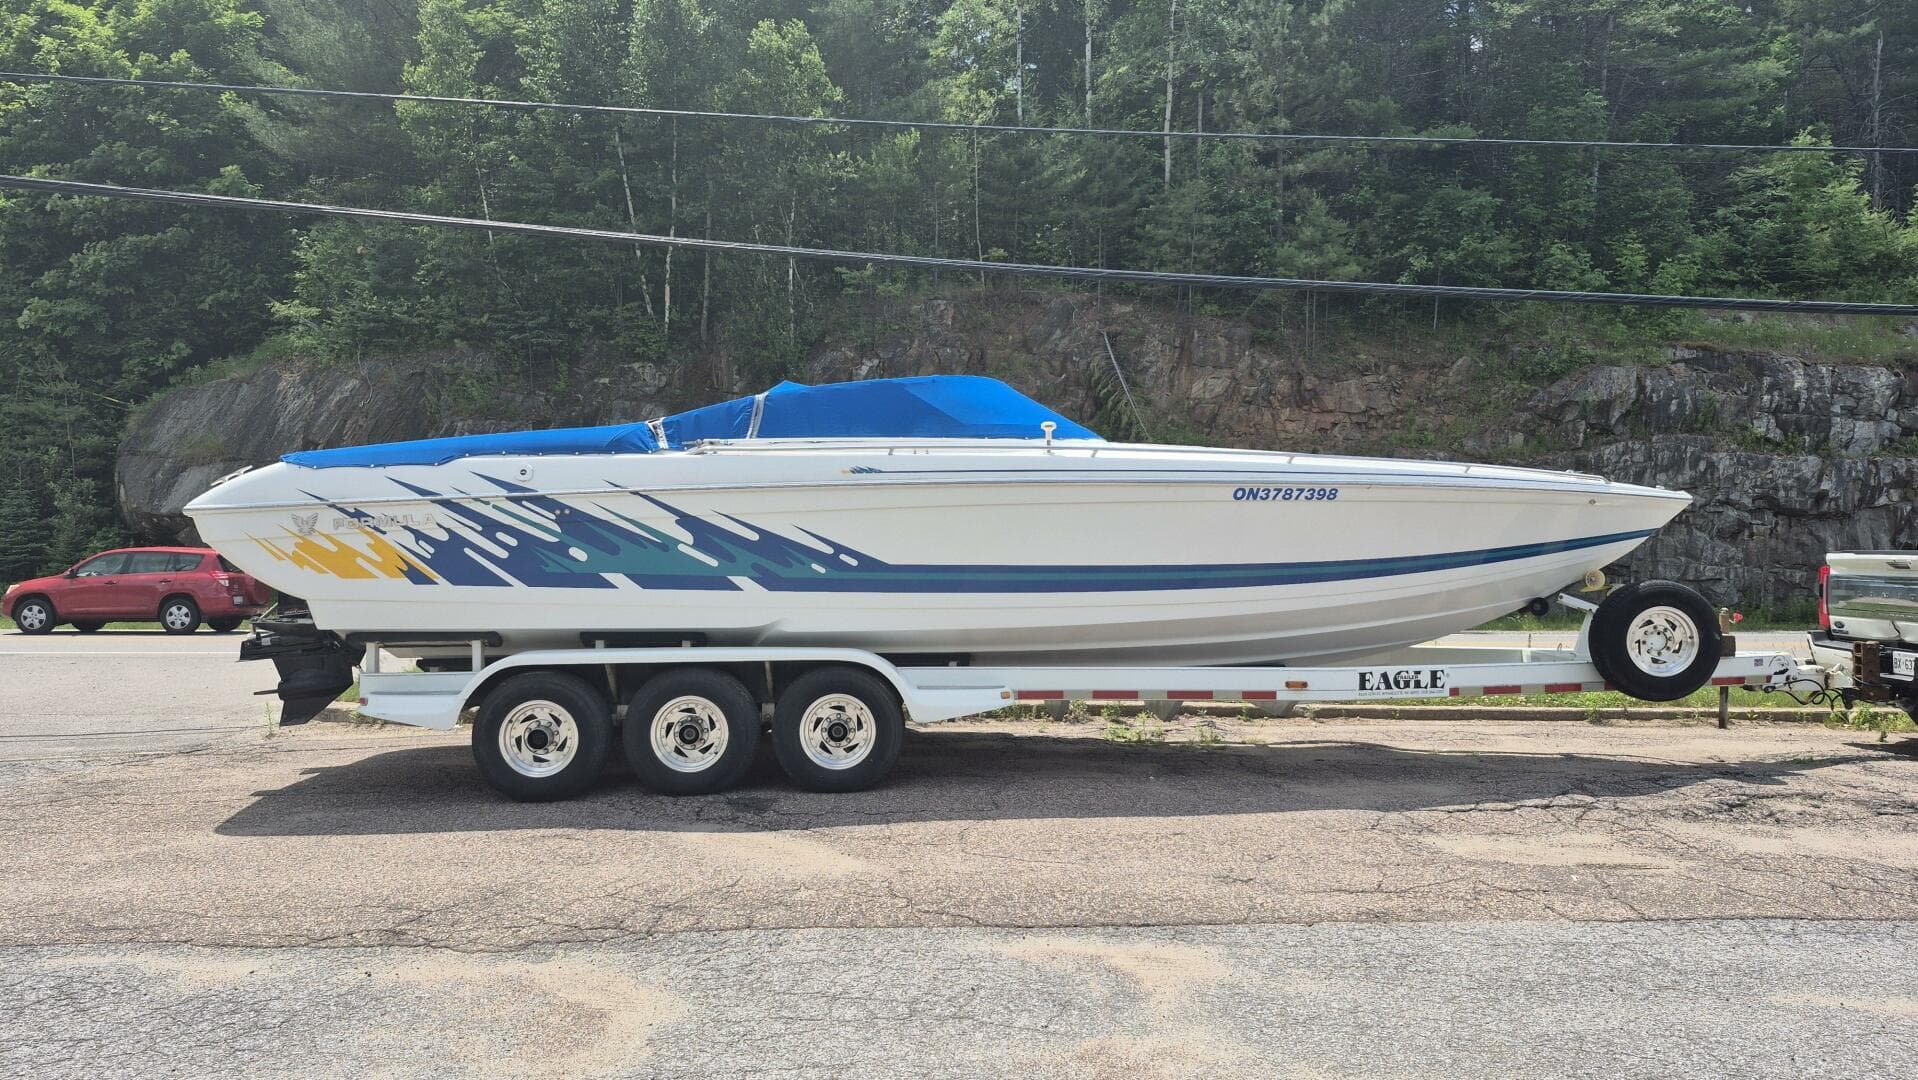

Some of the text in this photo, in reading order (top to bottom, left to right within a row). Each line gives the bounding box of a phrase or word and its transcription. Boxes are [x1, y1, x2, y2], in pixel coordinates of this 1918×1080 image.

[1232, 487, 1339, 501] ON3787398
[332, 511, 438, 530] FORMULA
[1358, 669, 1446, 691] EAGLE
